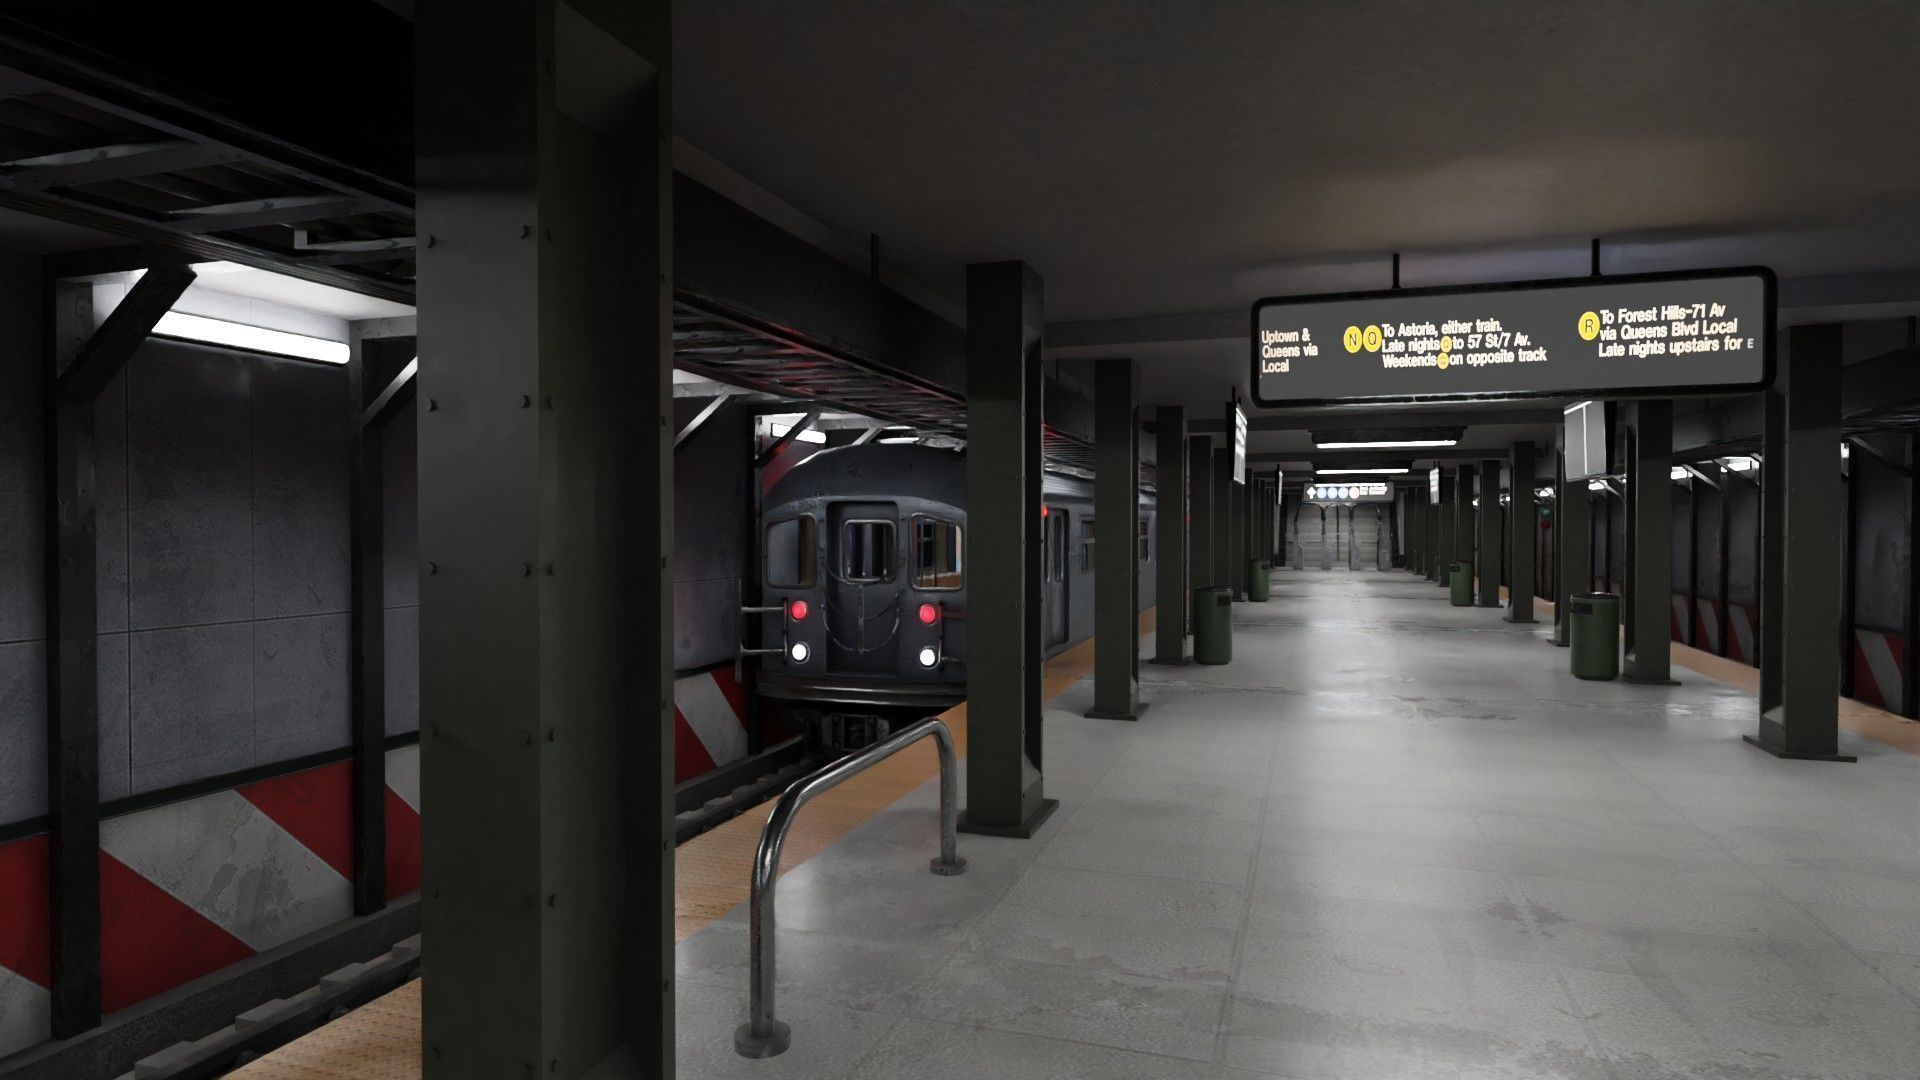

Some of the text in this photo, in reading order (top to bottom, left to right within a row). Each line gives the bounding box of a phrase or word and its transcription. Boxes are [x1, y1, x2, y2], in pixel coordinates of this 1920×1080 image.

[1600, 303, 1726, 325] To Forest Hills-71 Av
[1261, 328, 1310, 345] Uptown &
[1382, 318, 1502, 337] To Astoria, either train.
[1600, 318, 1737, 341] via Queens Blvd Local
[1262, 343, 1318, 358] Queens via
[1382, 339, 1405, 353] Late
[1408, 335, 1440, 355] nights
[1452, 337, 1464, 350] to
[1467, 334, 1482, 349] 57
[1485, 332, 1510, 348] St/7
[1513, 331, 1531, 346] Av.
[1599, 335, 1753, 359] Late nights upstairs for E
[1263, 359, 1289, 373] Local
[1383, 354, 1436, 368] Weekends
[1450, 354, 1463, 366] on
[1467, 349, 1514, 367] opposite
[1518, 348, 1548, 362] track
